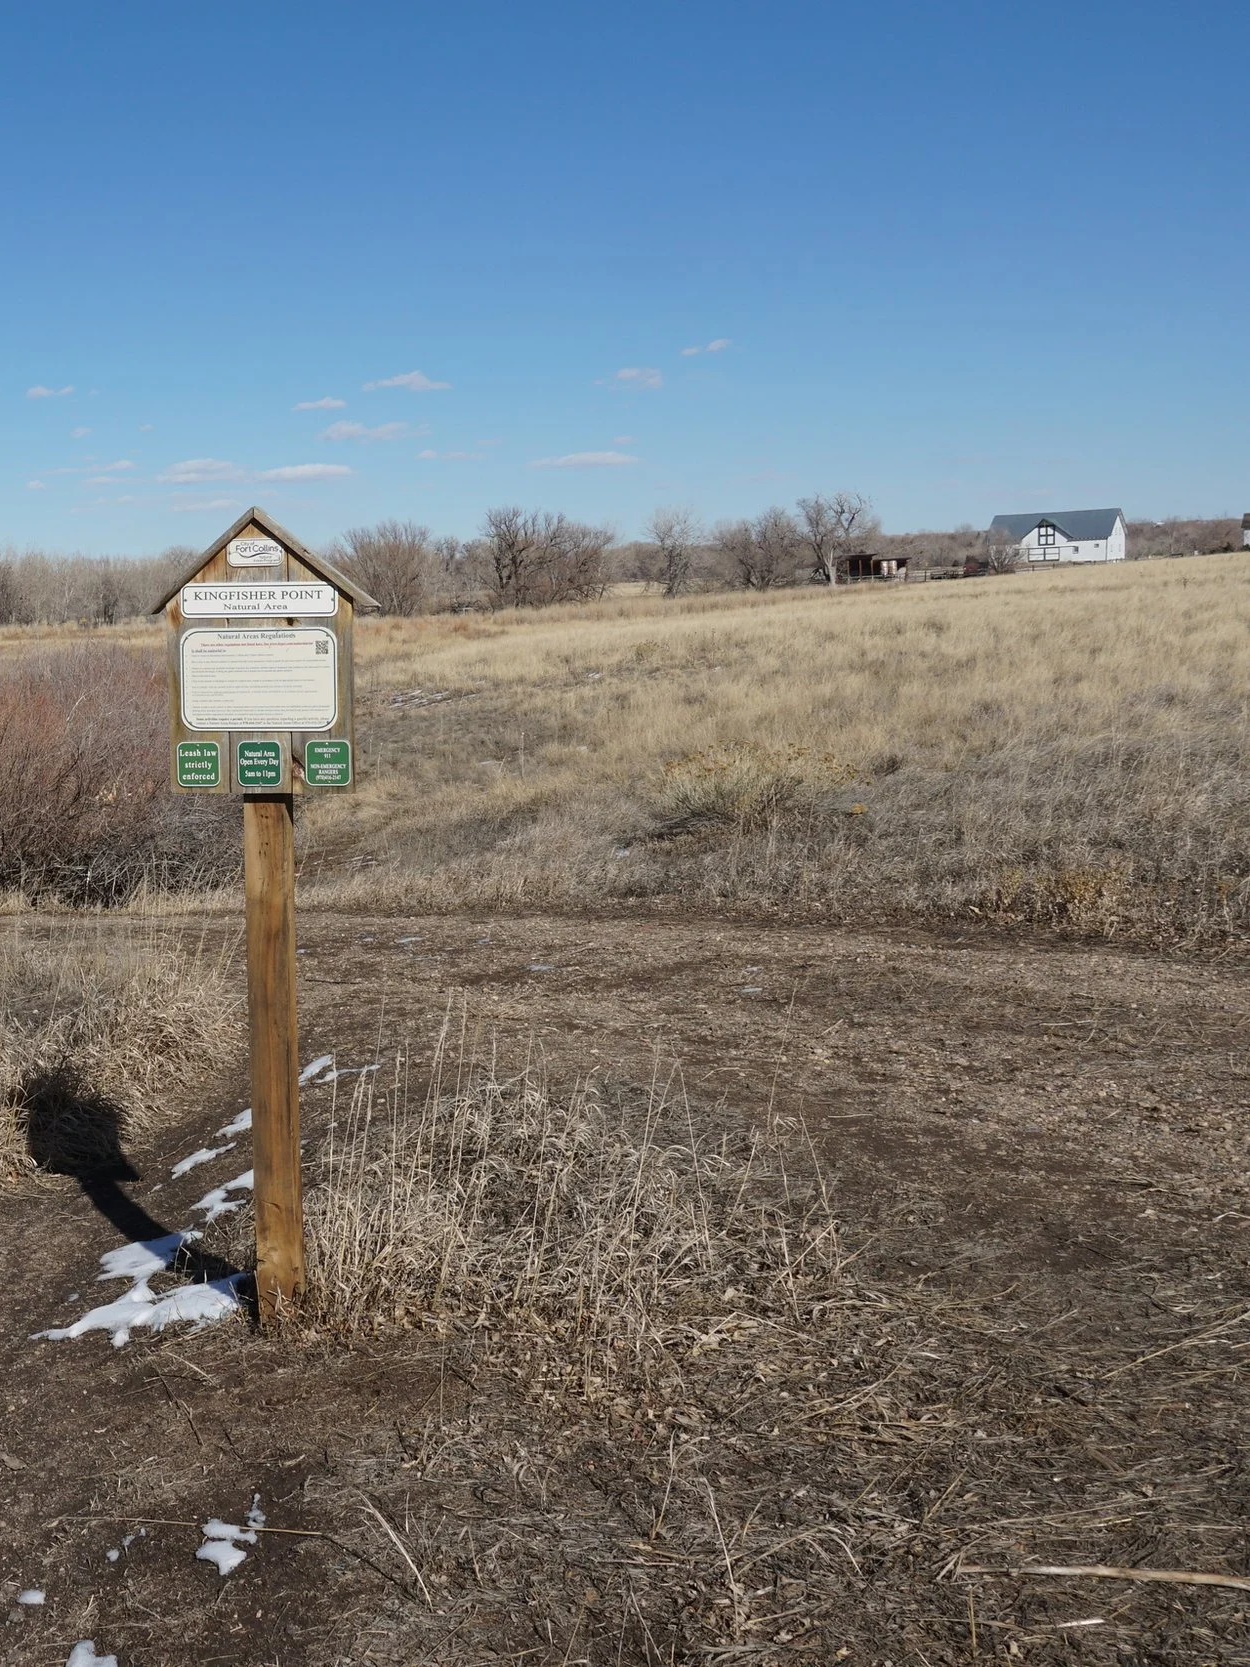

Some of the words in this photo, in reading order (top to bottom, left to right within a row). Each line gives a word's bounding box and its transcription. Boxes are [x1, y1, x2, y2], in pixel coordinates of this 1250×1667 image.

[252, 544, 279, 552] Collins
[194, 590, 276, 601] KINGFISHER
[281, 590, 324, 600] POINT
[260, 632, 296, 640] Regulations
[180, 749, 201, 757] Leash
[203, 749, 217, 757] law
[184, 760, 212, 770] strictly
[240, 758, 253, 766] Open
[254, 758, 268, 766] Every
[268, 758, 279, 766] Day
[182, 772, 215, 780] enforced
[262, 770, 276, 778] 11pm
